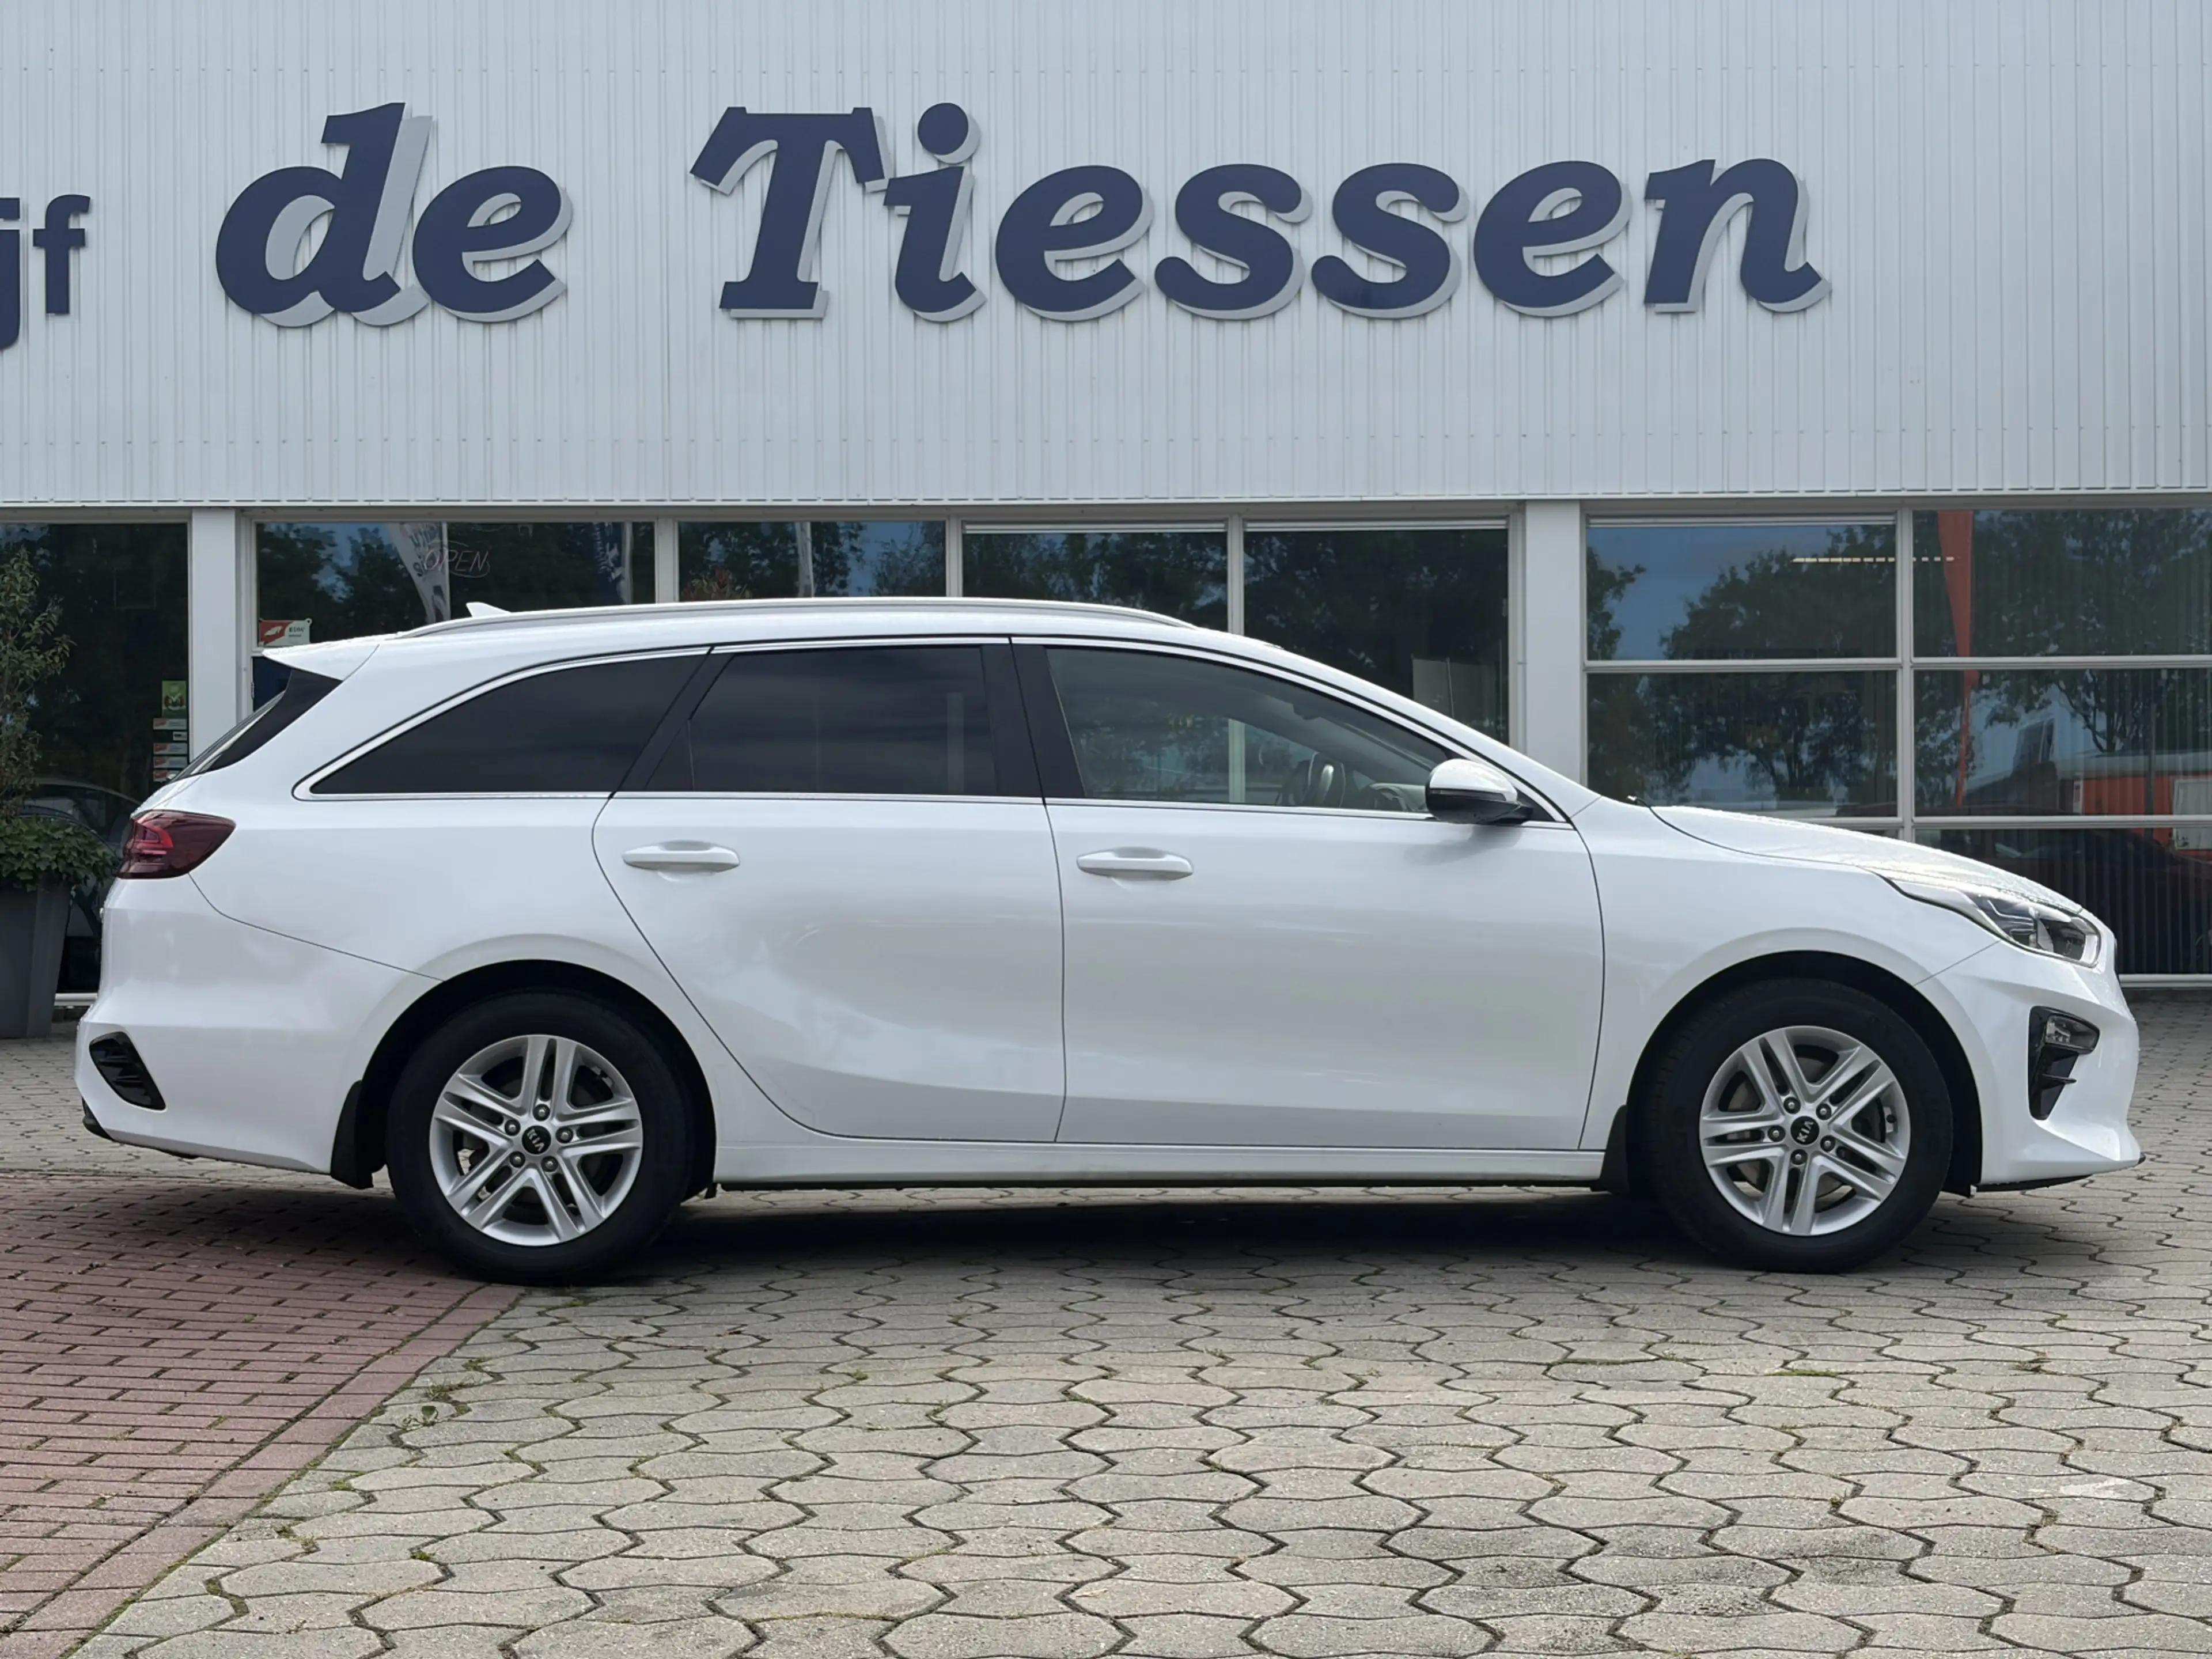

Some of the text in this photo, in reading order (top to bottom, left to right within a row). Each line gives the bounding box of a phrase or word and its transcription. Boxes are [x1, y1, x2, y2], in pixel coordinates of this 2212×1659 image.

[216, 103, 567, 324] de
[690, 103, 1827, 321] Tiessen
[424, 547, 489, 571] OPEN
